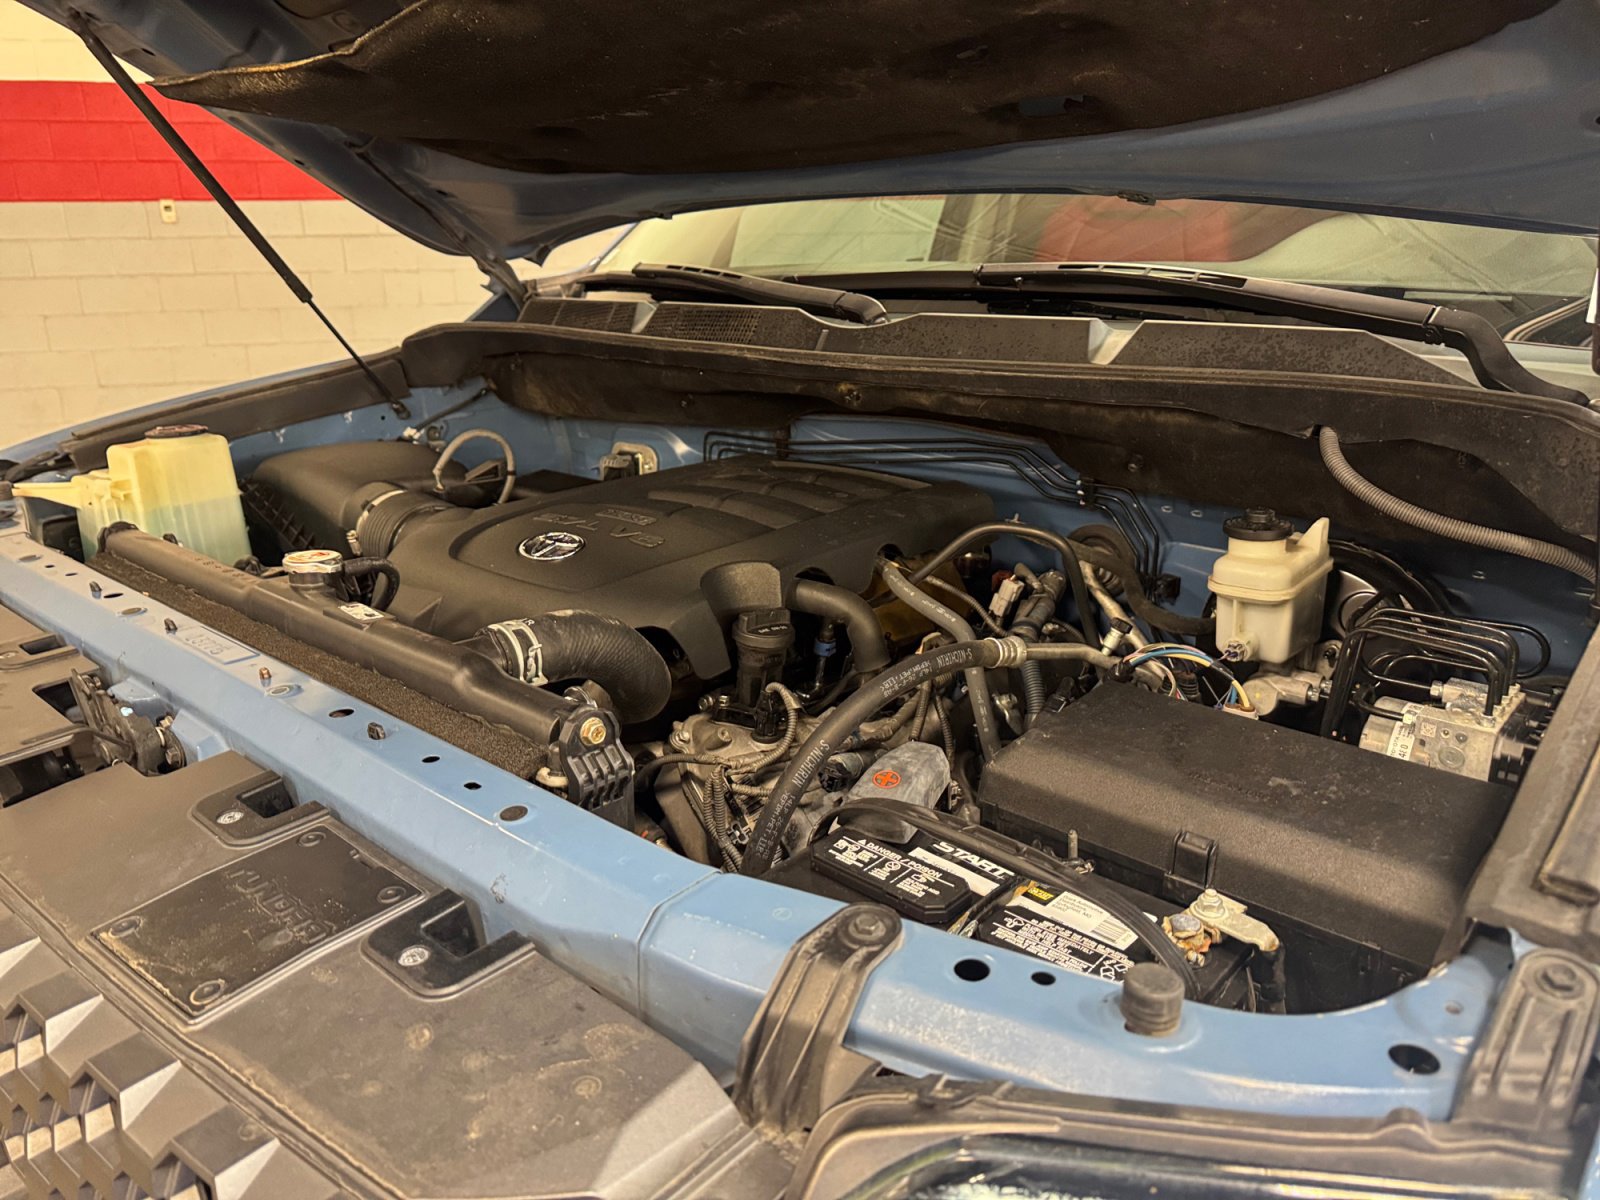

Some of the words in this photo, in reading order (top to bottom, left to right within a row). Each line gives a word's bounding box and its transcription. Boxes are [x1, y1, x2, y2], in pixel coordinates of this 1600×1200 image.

[866, 842, 902, 860] DANGER
[907, 861, 943, 878] POISON
[932, 841, 1015, 876] START
